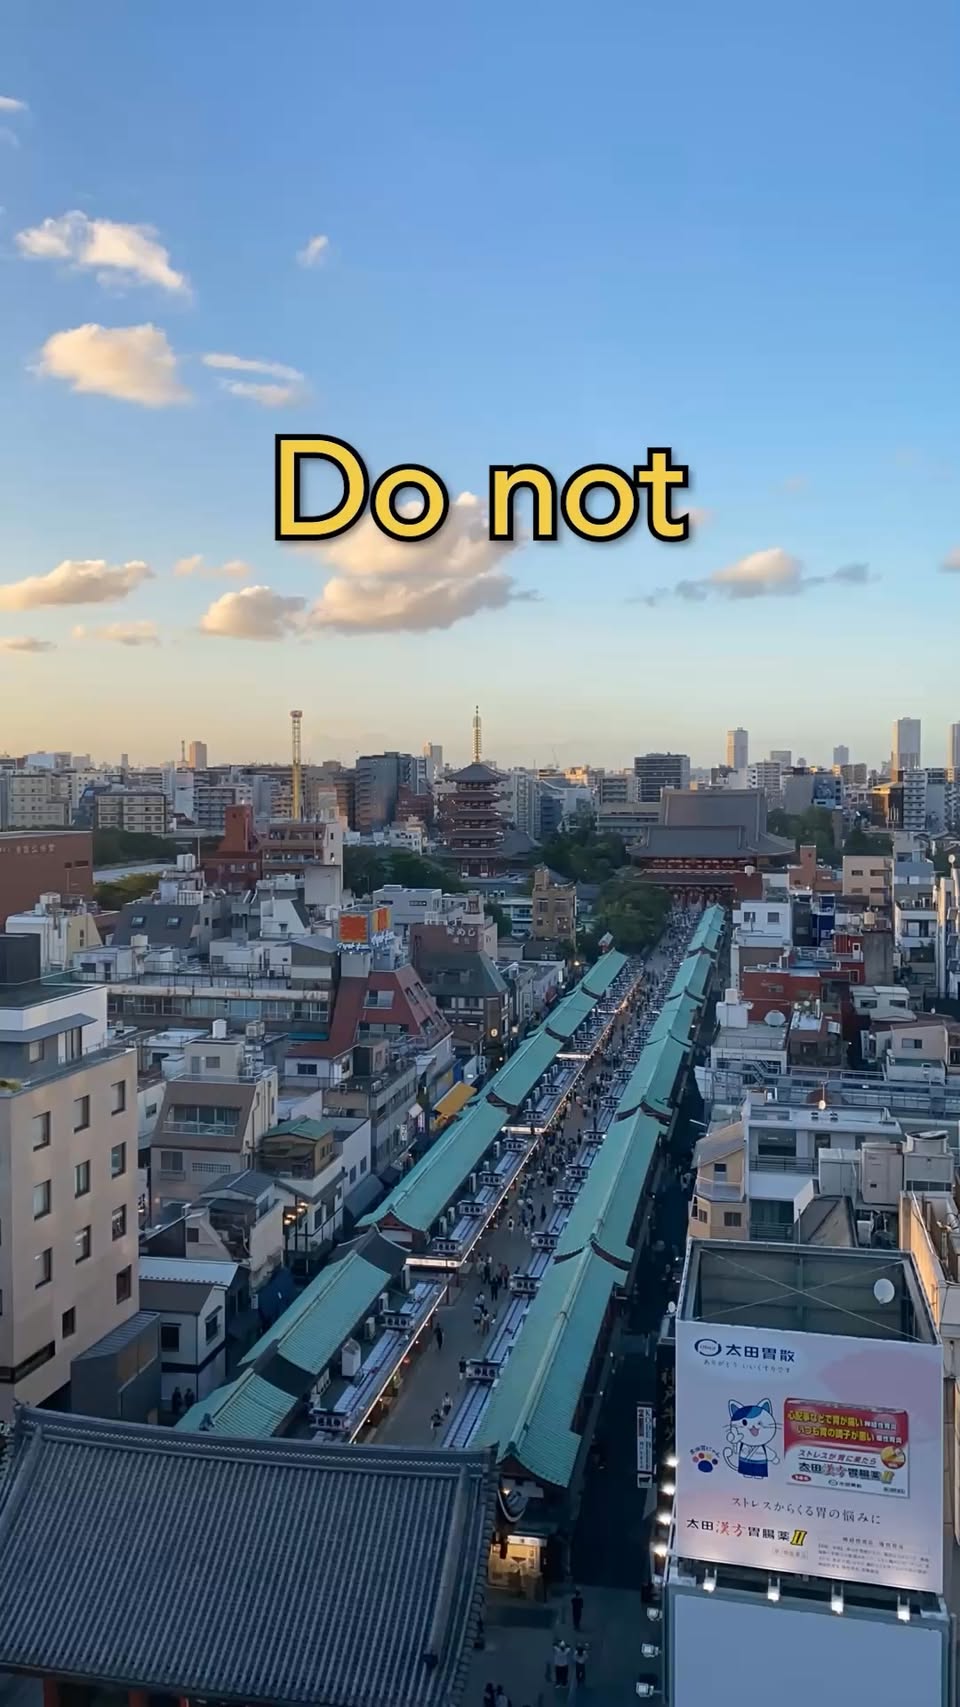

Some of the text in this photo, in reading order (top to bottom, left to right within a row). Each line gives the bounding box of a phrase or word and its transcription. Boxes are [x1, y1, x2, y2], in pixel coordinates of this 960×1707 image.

[725, 1344, 795, 1362] 太田胃散
[732, 1497, 881, 1525] ストレスからくる胃の悩みに
